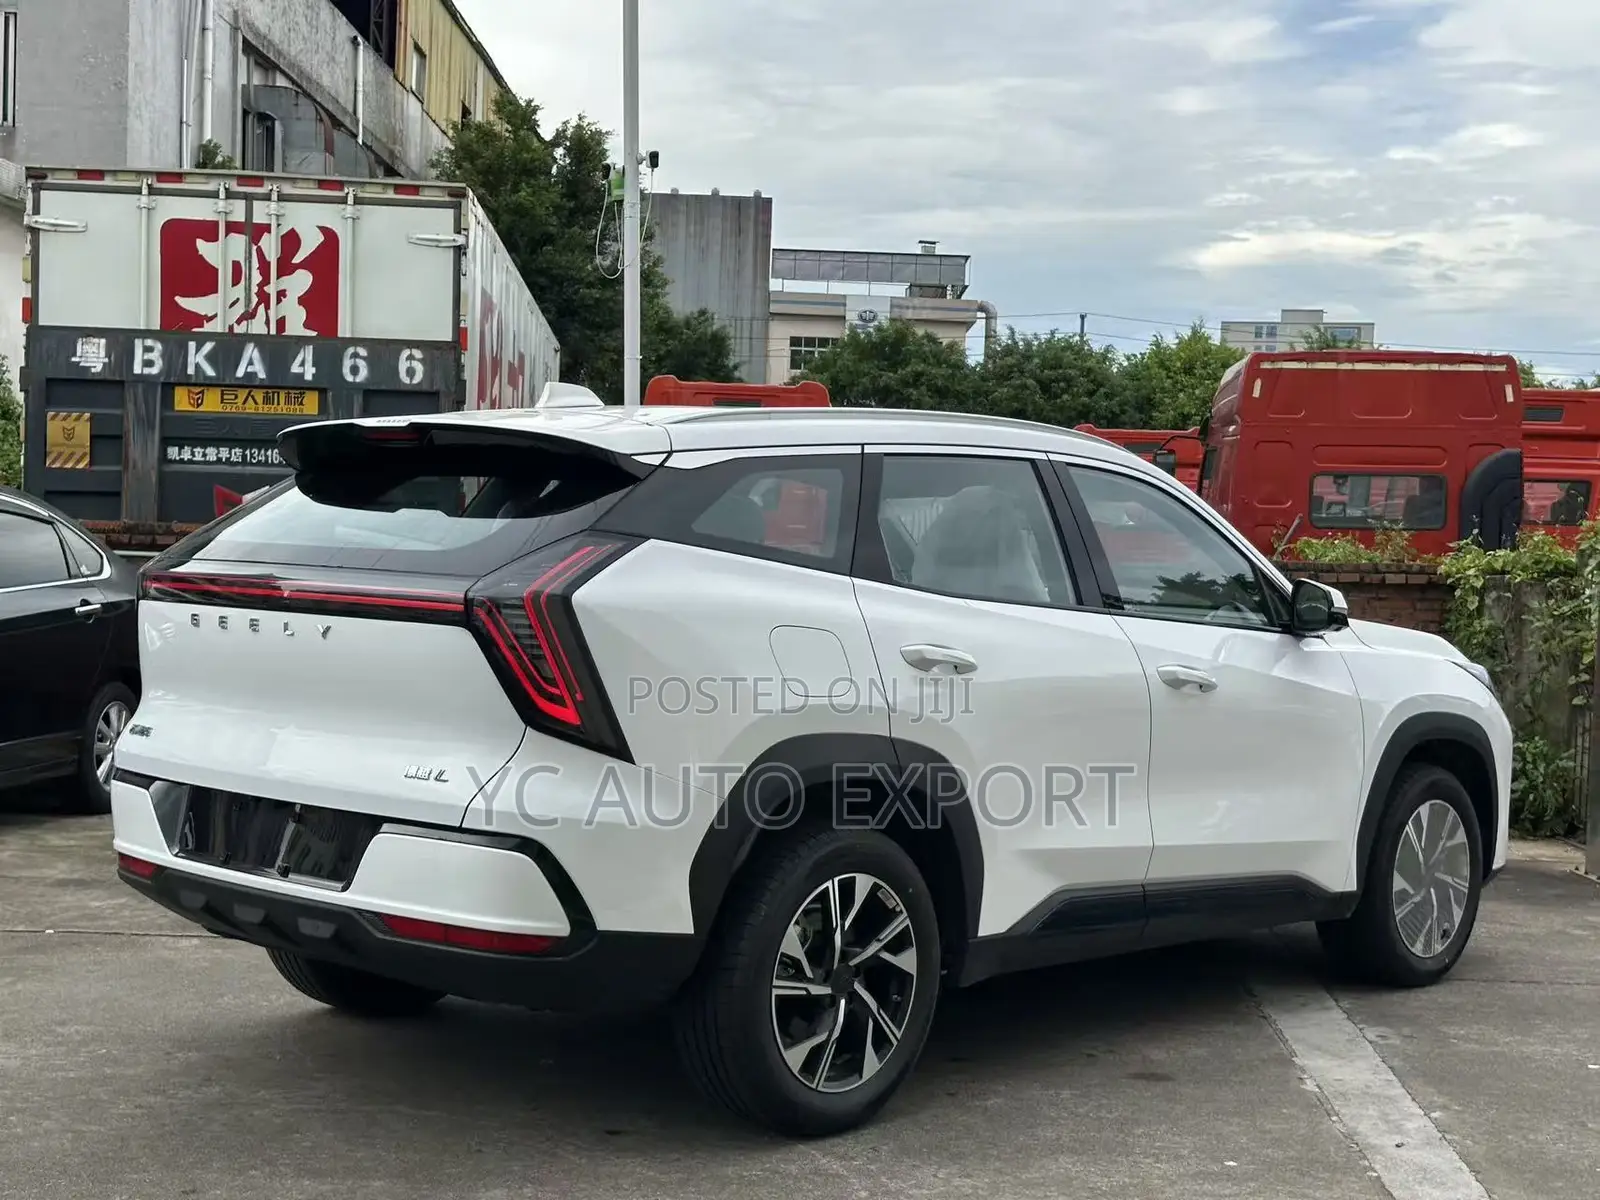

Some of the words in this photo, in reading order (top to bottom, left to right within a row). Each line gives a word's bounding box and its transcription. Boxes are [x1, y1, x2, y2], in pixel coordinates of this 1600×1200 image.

[220, 389, 305, 407] 巨人机械
[190, 613, 332, 640] GEELY
